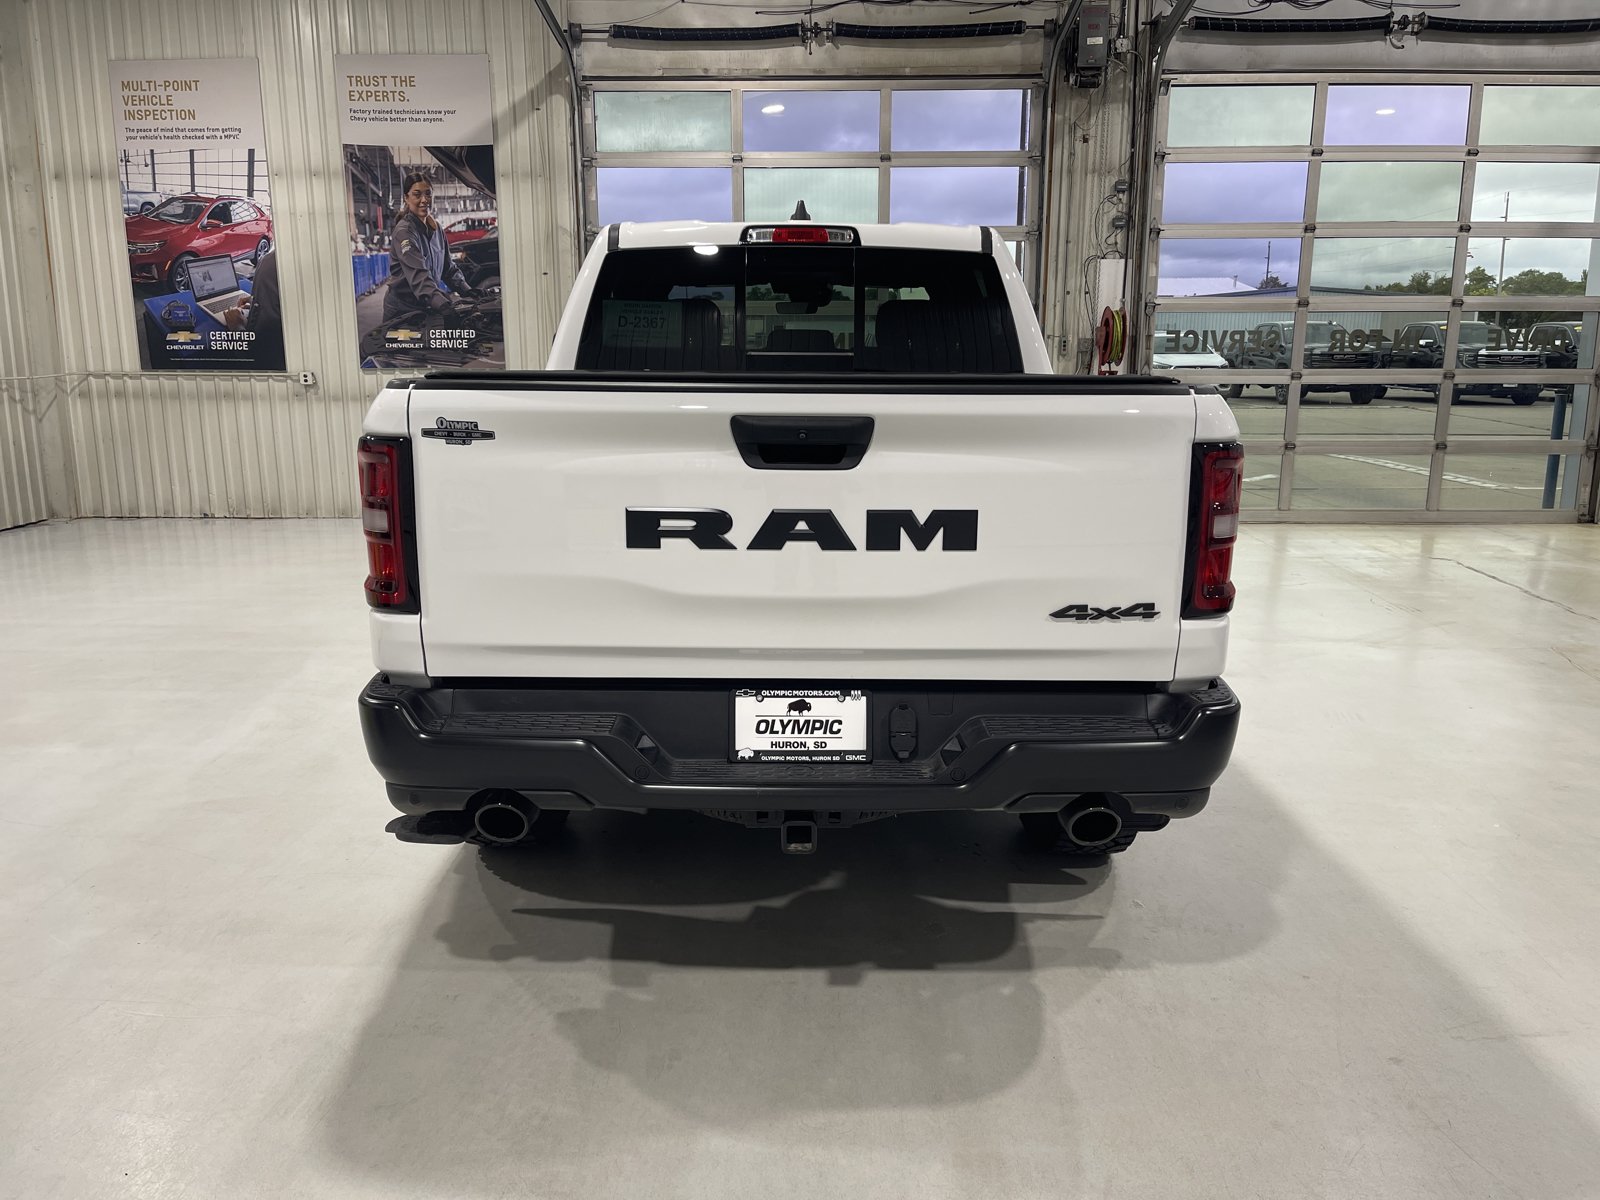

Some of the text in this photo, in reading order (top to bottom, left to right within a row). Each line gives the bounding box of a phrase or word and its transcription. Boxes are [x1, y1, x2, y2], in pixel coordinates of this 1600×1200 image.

[121, 80, 200, 92] MULTI-POINT
[347, 75, 416, 87] TRUST THE
[122, 94, 173, 106] VEHICLE
[348, 90, 410, 102] EXPERTS.
[124, 109, 196, 121] INSPECTION
[349, 107, 371, 115] Factory
[349, 115, 367, 123] Chevy
[221, 126, 242, 134] getting
[618, 314, 666, 329] D-2367
[209, 331, 256, 341] CERTIFIED
[429, 329, 476, 339] CERTIFIED
[210, 341, 249, 351] SERVICE
[430, 339, 469, 349] SERVICE
[436, 417, 478, 430] OLYMPIC
[625, 506, 979, 552] RAM
[1048, 602, 1161, 621] 4x4
[755, 719, 843, 735] OLYMPIC
[770, 741, 827, 750] HURON, SD
